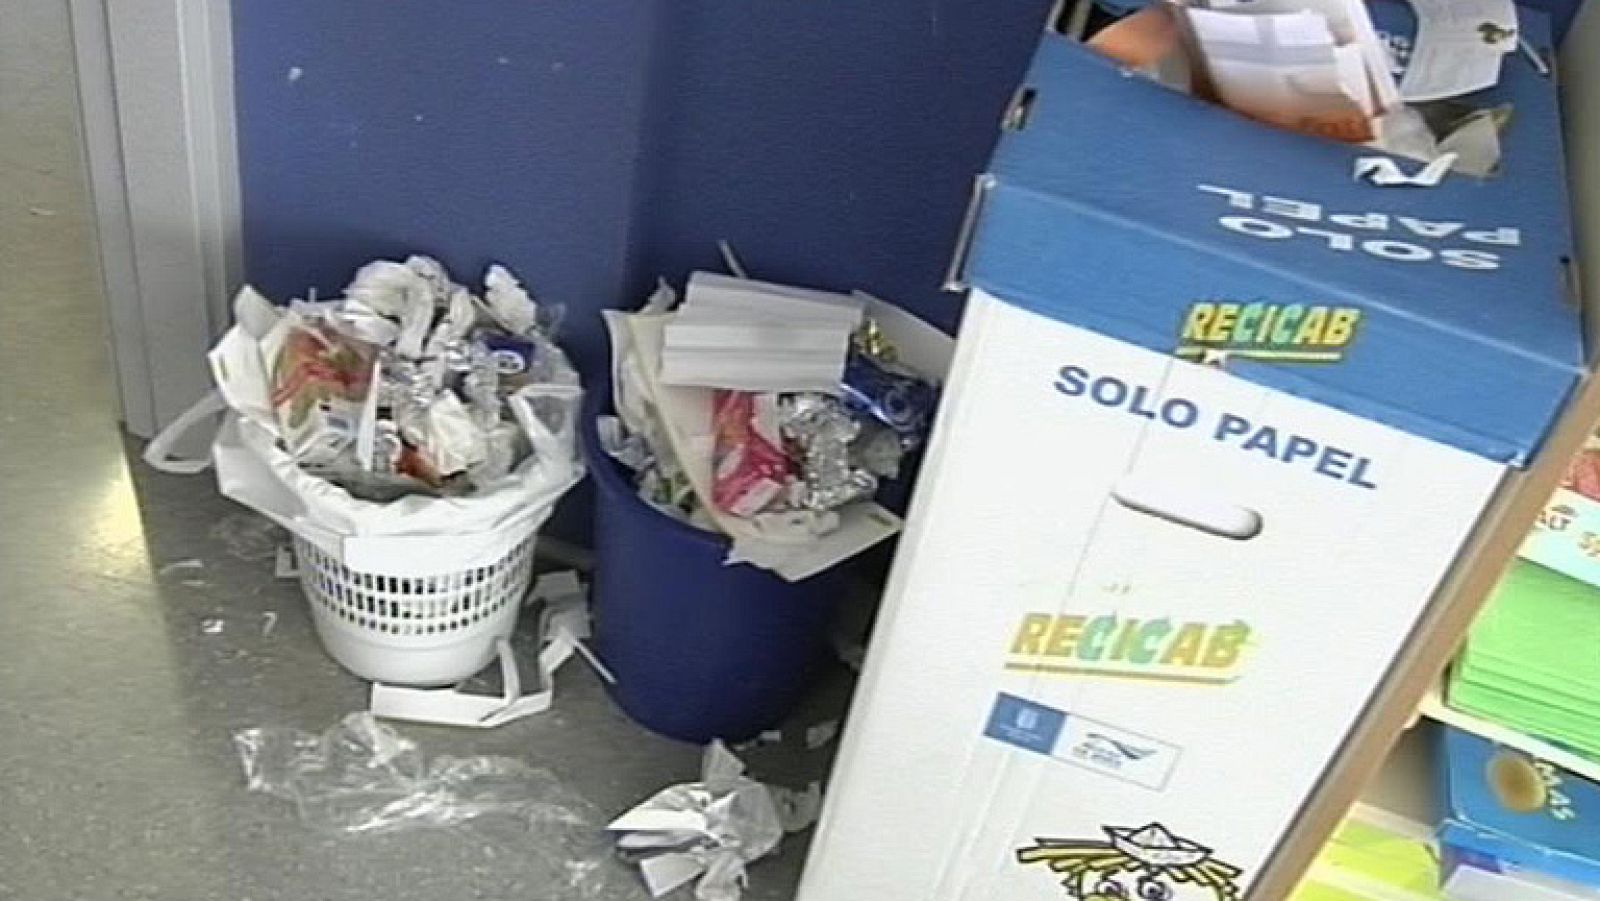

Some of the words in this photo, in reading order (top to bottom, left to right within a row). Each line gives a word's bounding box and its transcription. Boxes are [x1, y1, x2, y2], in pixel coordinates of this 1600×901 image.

[1196, 184, 1521, 246] PAPEL
[1217, 215, 1500, 270] SOLO
[1182, 301, 1362, 346] RECICAB
[1053, 364, 1199, 429] SOLO
[1213, 412, 1378, 490] PAPEL
[1009, 611, 1252, 668] RECICAB
